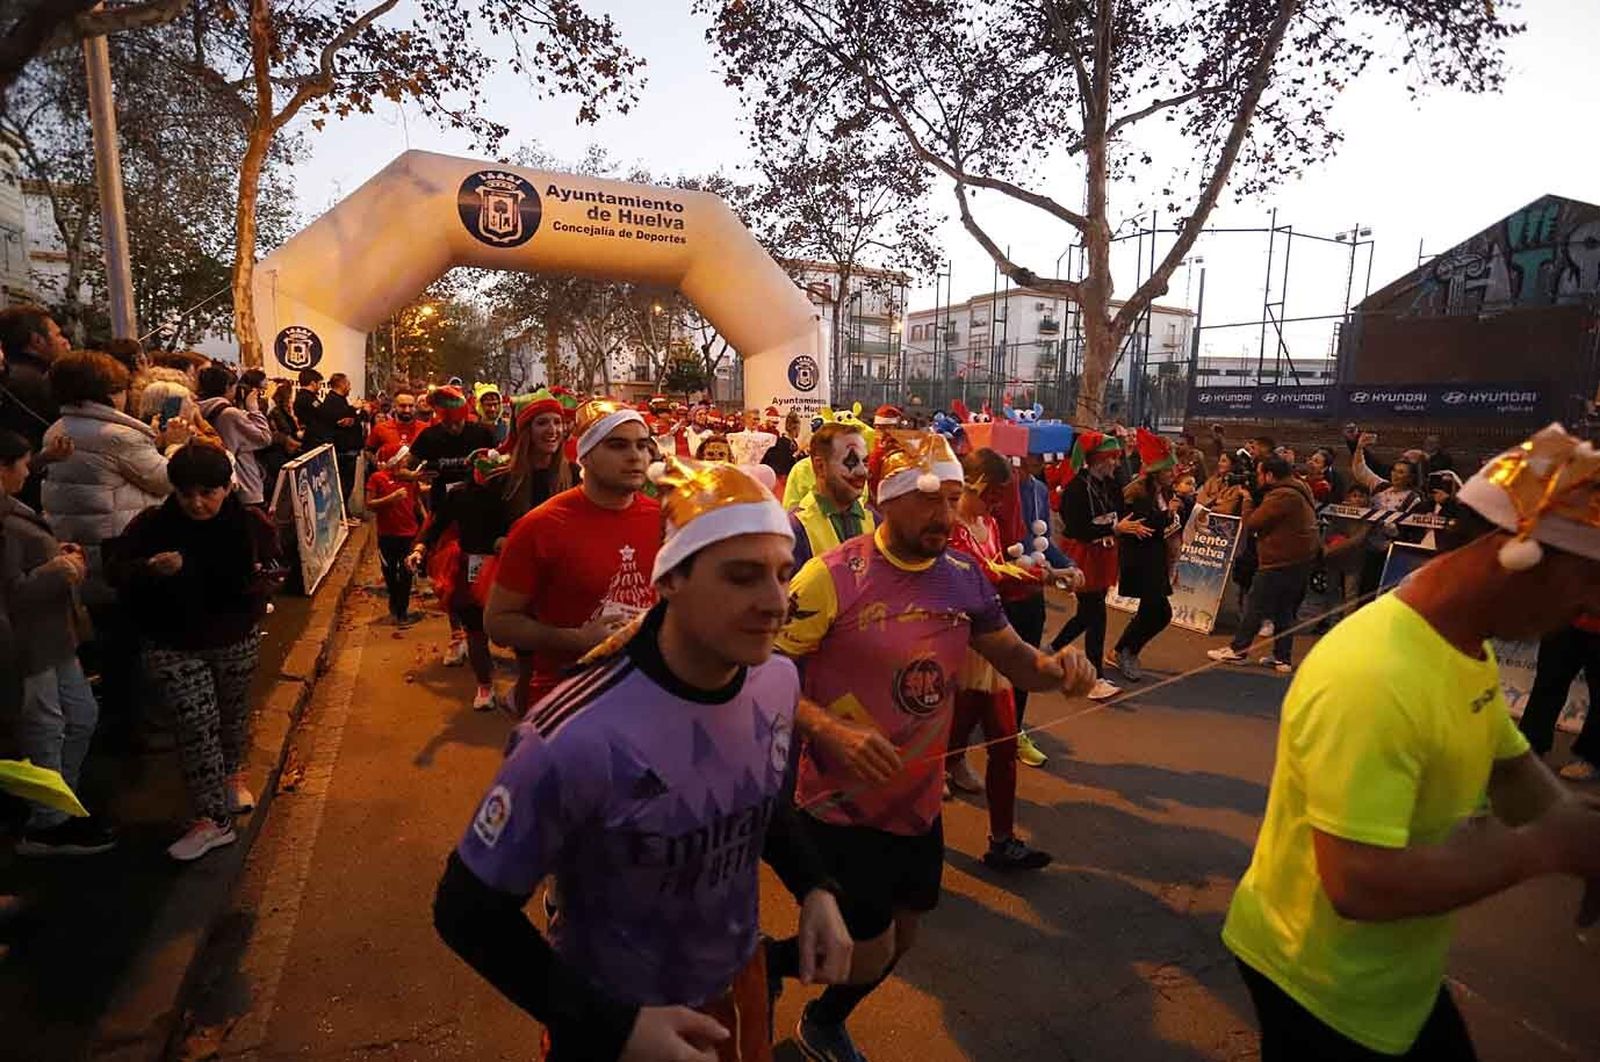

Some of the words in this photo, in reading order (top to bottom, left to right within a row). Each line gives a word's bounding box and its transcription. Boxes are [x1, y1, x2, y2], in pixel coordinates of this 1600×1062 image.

[546, 184, 684, 213] Ayuntamiento
[587, 206, 611, 221] de
[618, 209, 684, 230] Huelva
[619, 230, 633, 238] de
[636, 231, 686, 244] Deportes
[1213, 394, 1252, 402] HYUNDAI
[1280, 394, 1325, 402] HYUNDAI
[1372, 393, 1427, 402] HYUNDAI
[1469, 392, 1537, 402] HYUNDAI
